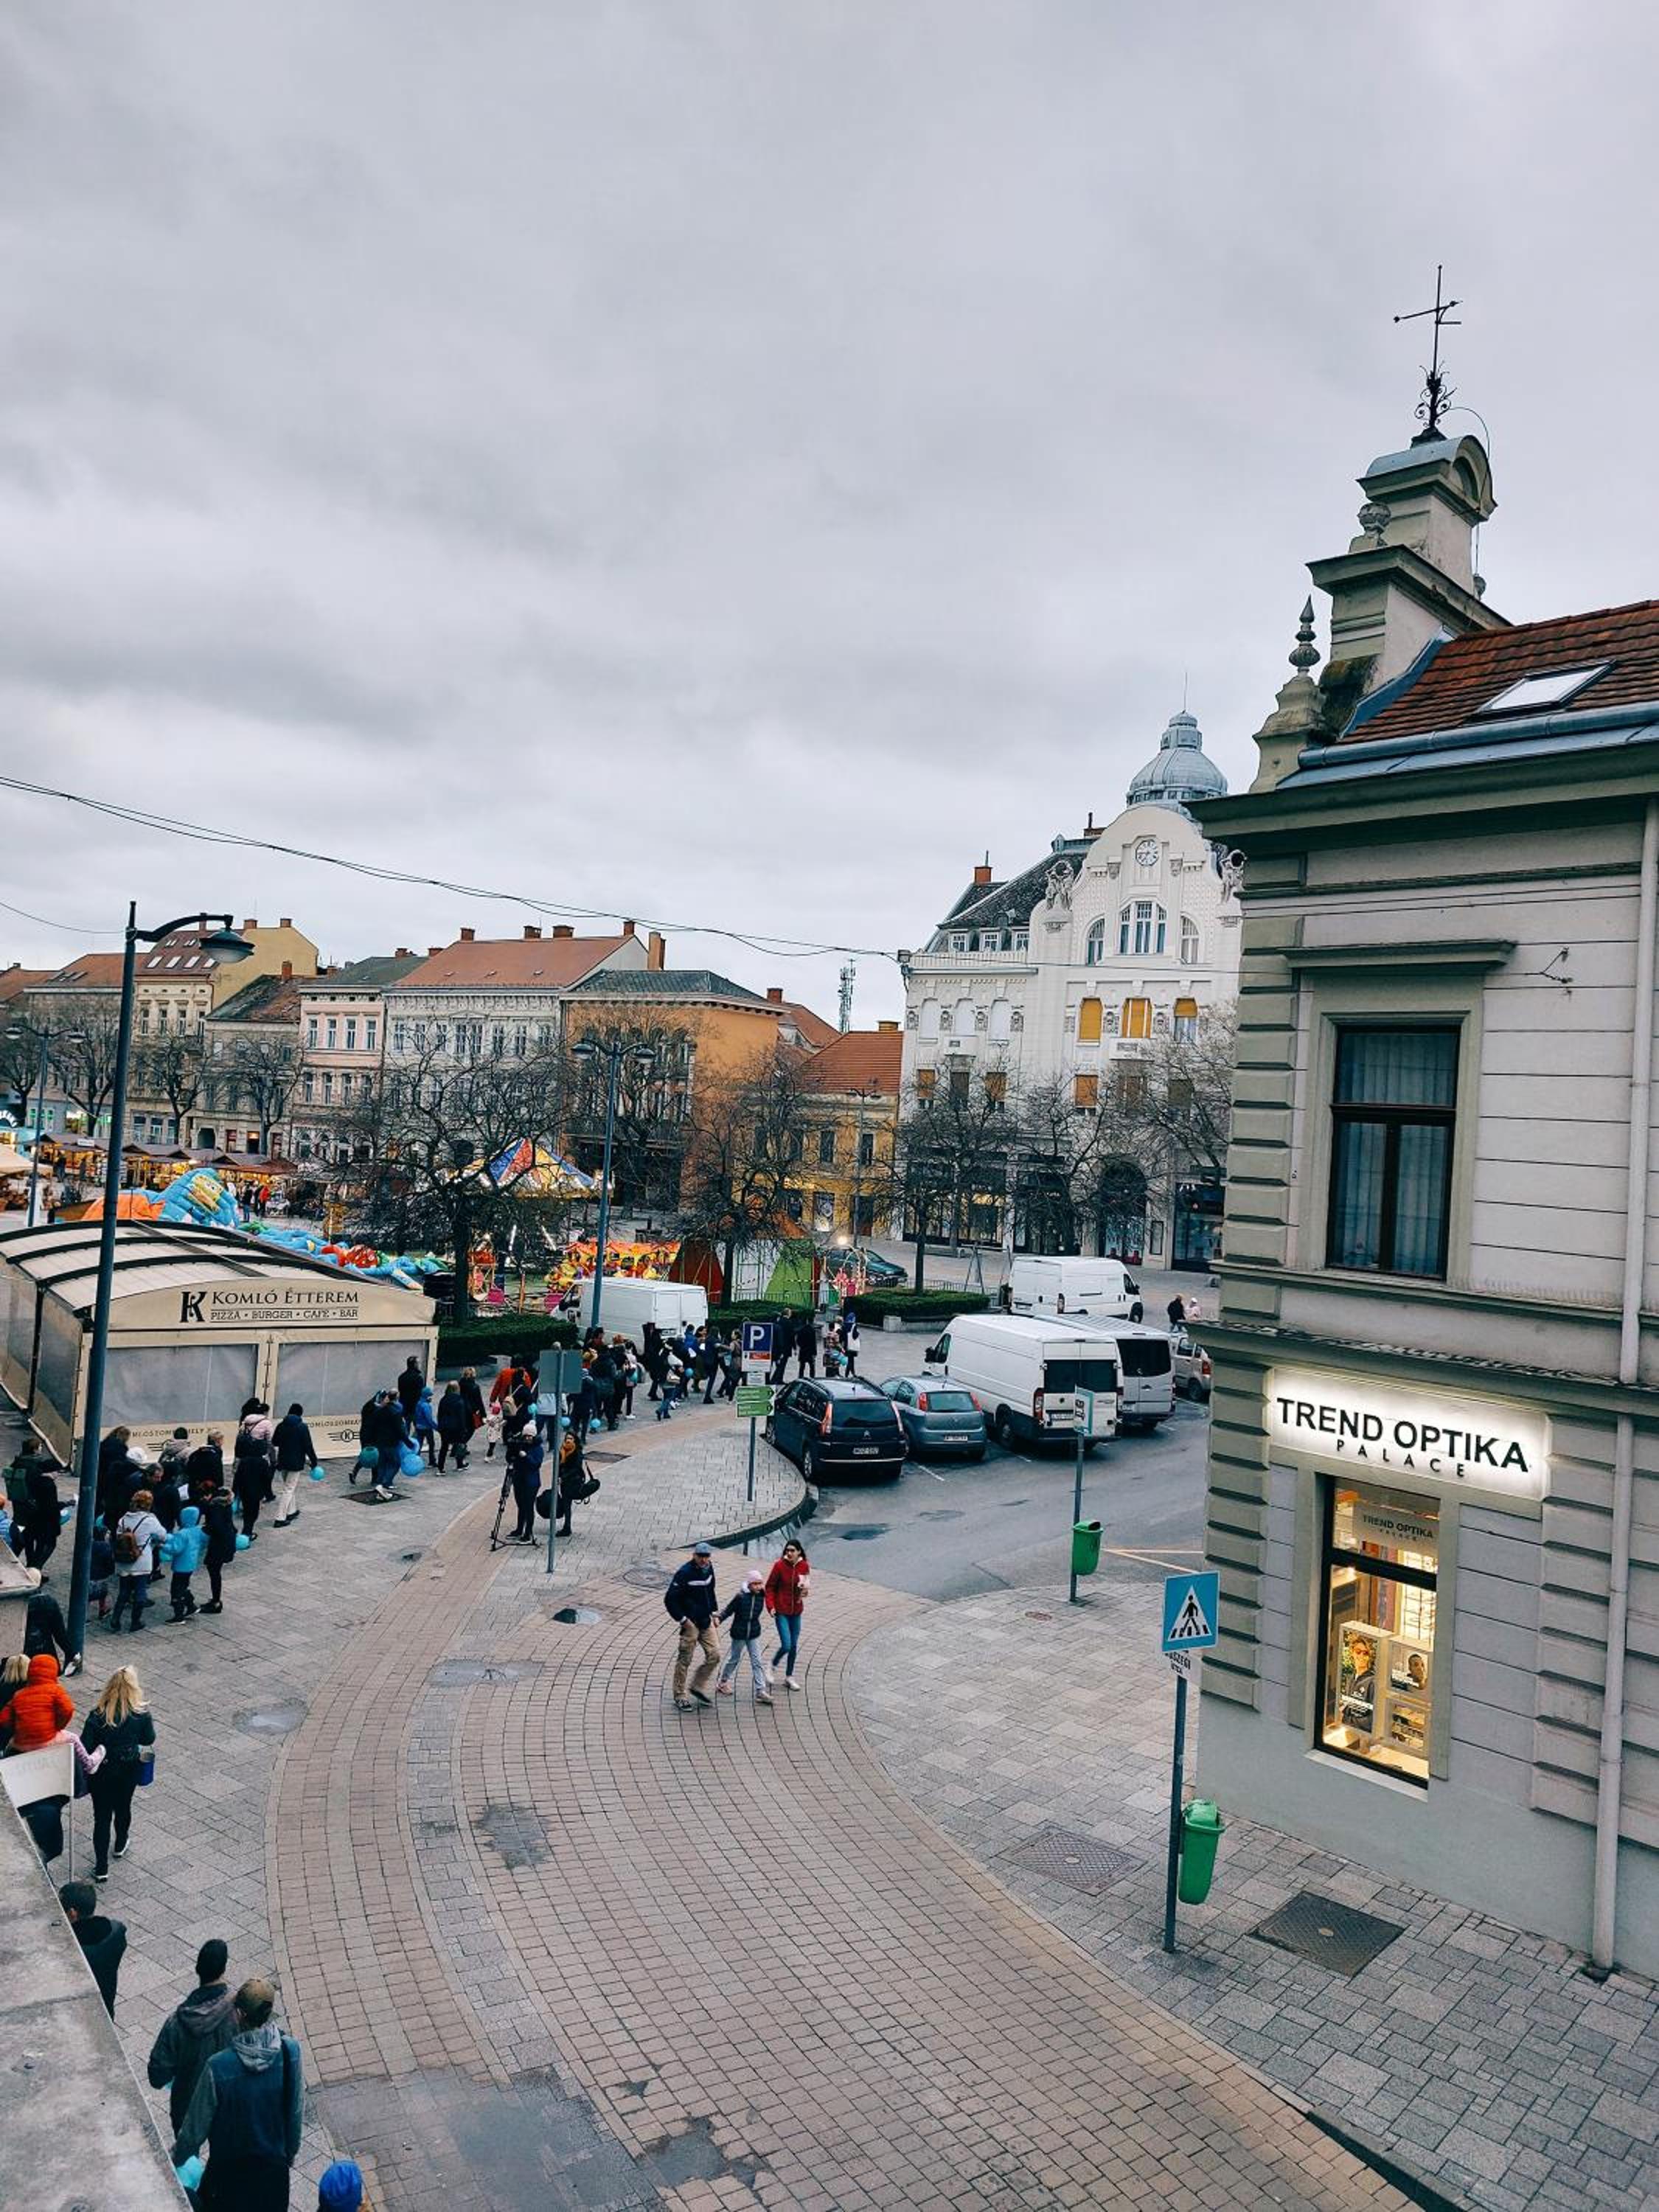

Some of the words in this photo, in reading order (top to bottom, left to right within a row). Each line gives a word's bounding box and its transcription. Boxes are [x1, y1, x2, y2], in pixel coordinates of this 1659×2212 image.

[212, 1290, 277, 1304] KOMLÓ
[285, 1288, 358, 1304] ÉTTEREM
[211, 1311, 241, 1320] PIZZA
[251, 1310, 293, 1319] BURGER
[749, 1326, 765, 1349] P
[1276, 1397, 1383, 1441] TREND
[1394, 1421, 1528, 1472] OPTIKA
[1337, 1439, 1465, 1477] PALACE
[1363, 1515, 1394, 1528] TREND
[1397, 1523, 1434, 1539] OPTIKA
